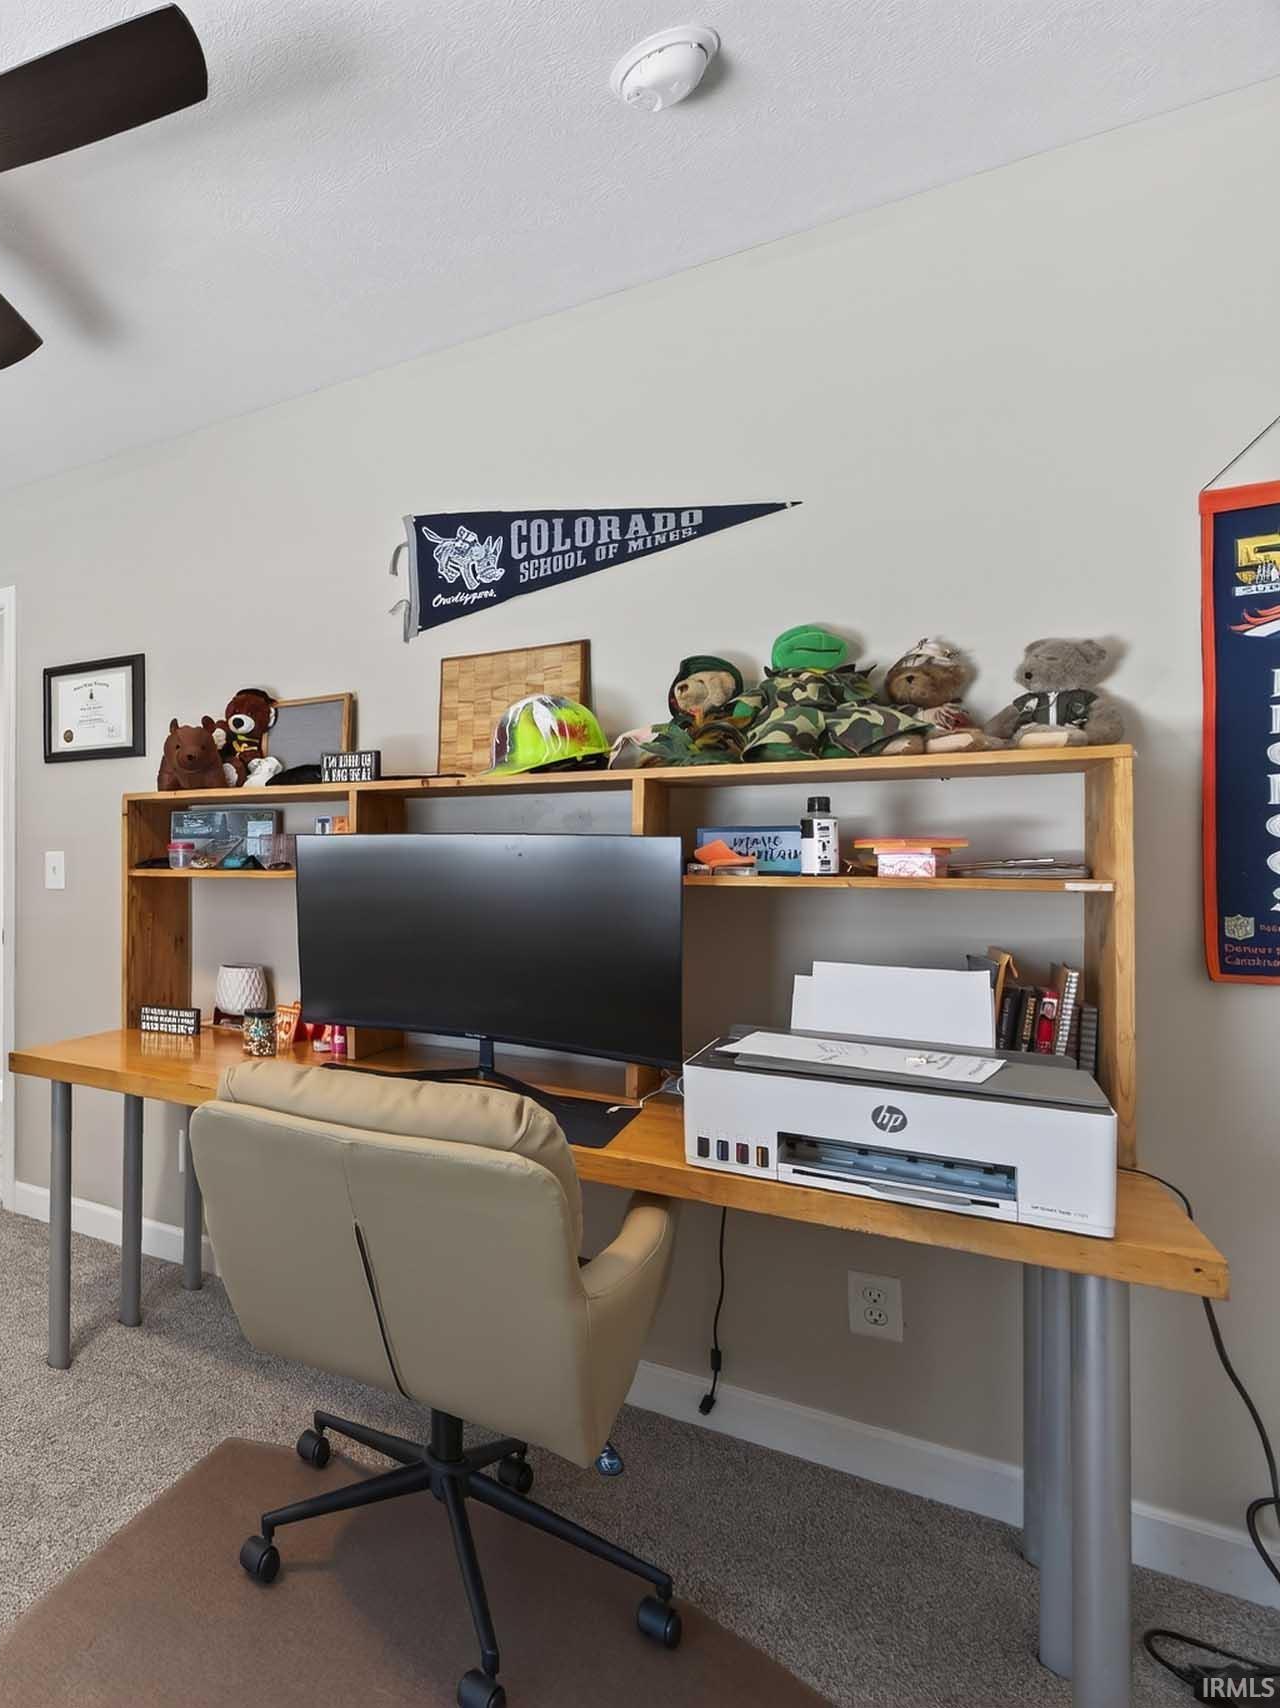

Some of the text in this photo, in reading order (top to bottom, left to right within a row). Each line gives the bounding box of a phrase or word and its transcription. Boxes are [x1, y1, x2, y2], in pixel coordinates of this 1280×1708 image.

[510, 509, 703, 560] COLORADO
[519, 550, 587, 584] SCHOOL
[595, 543, 619, 562] OF
[876, 1104, 904, 1132] hp
